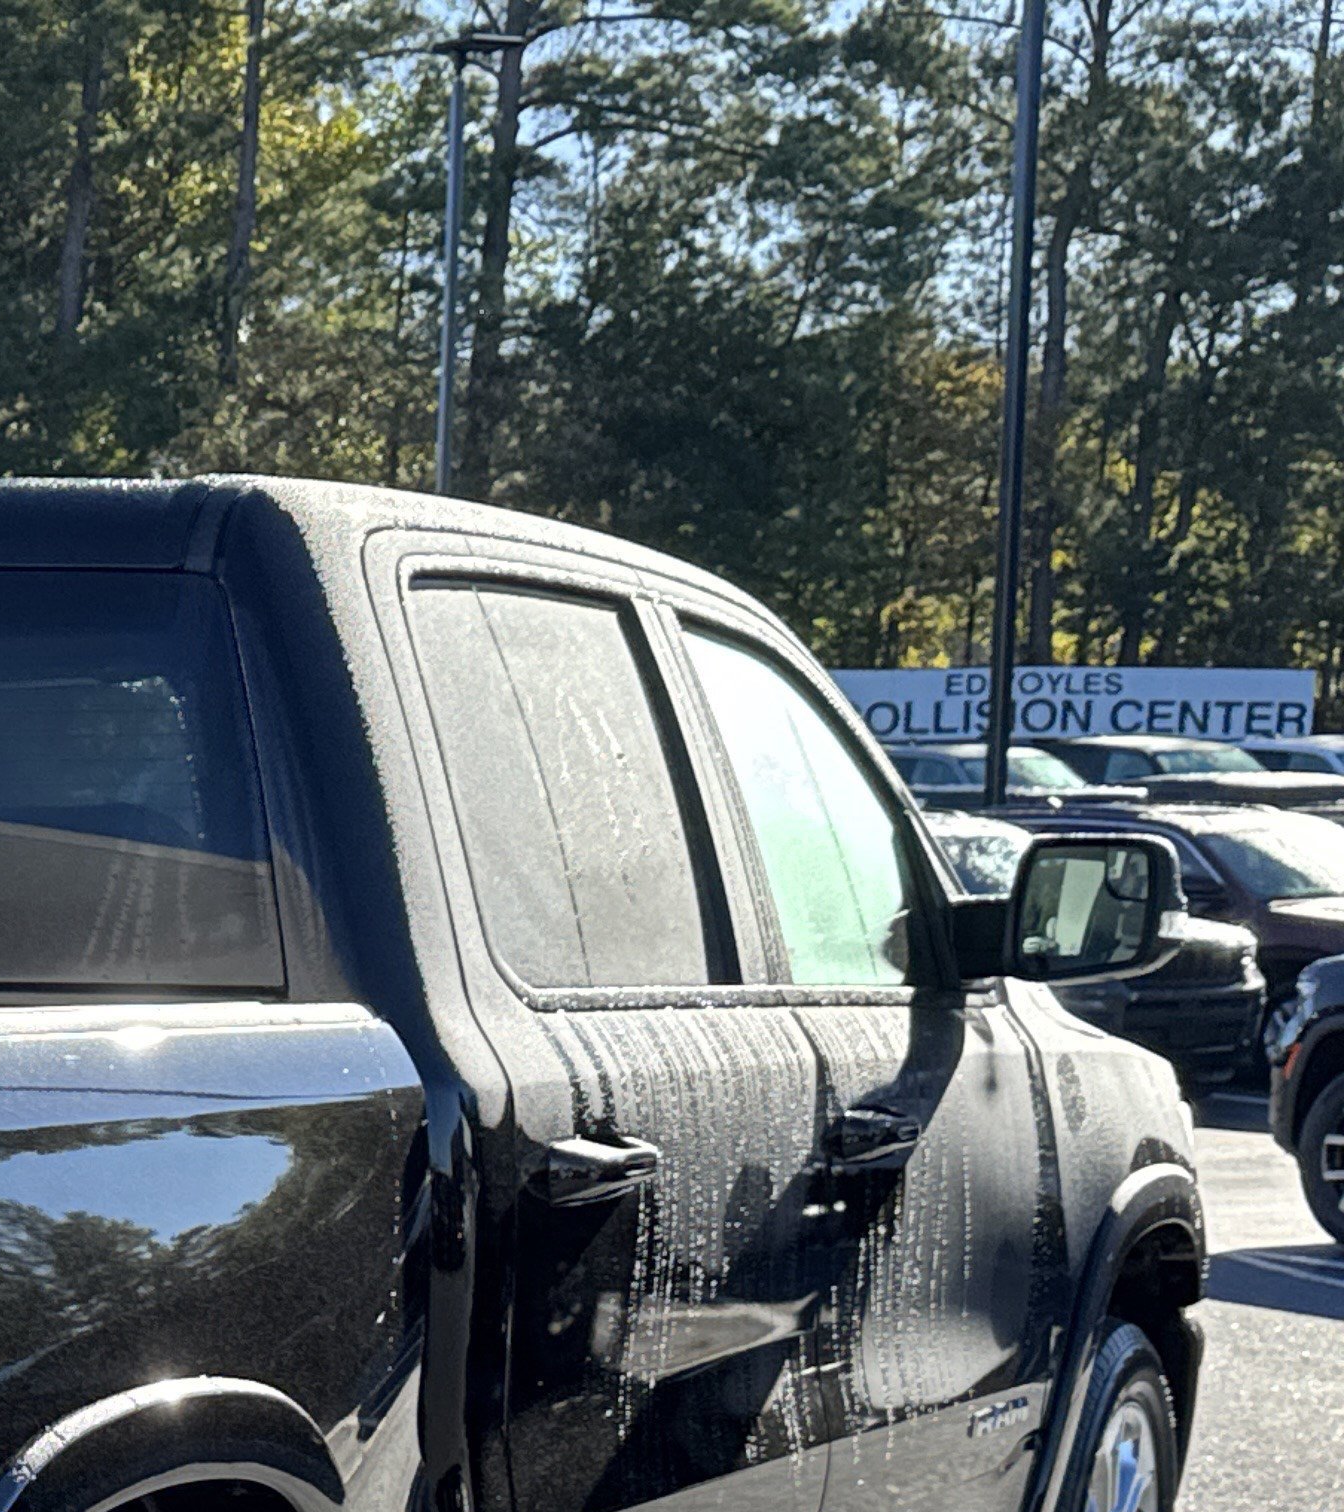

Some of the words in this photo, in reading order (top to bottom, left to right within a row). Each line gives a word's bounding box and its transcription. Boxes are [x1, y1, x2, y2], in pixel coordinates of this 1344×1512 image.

[945, 672, 987, 697] ED
[1011, 671, 1123, 696] OYLES
[855, 698, 1093, 735] OLLISON
[1110, 699, 1308, 738] CENTER
